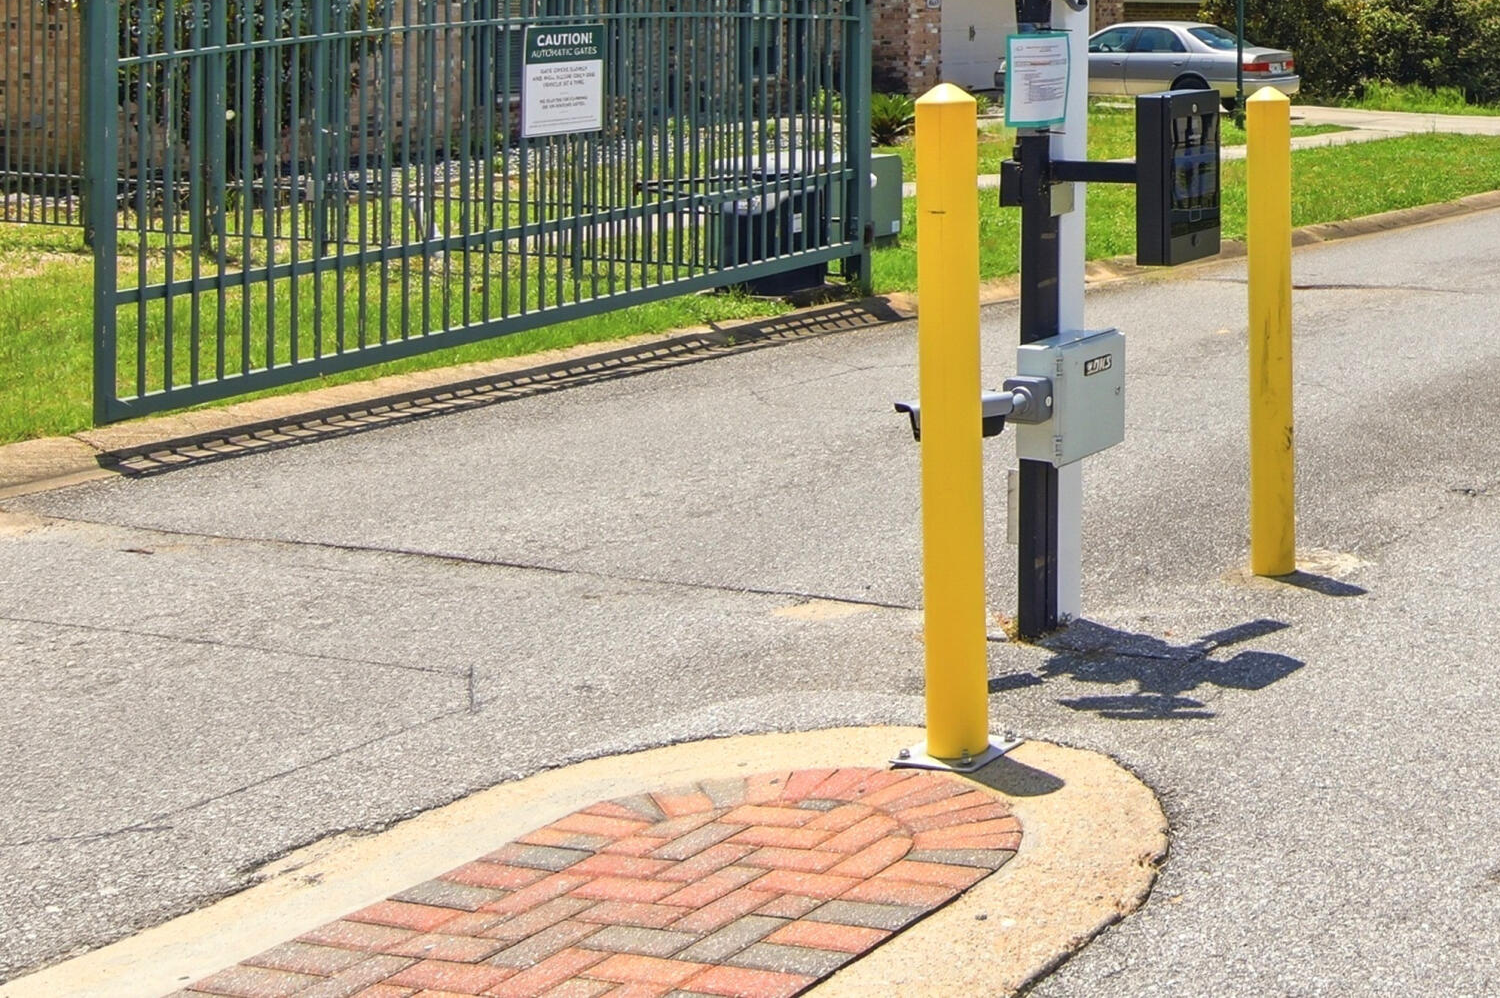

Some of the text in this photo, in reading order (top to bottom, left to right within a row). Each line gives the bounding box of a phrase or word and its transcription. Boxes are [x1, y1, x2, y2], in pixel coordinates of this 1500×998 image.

[537, 32, 593, 46] CAUTION!
[531, 46, 598, 58] AUTOMATIC GATES
